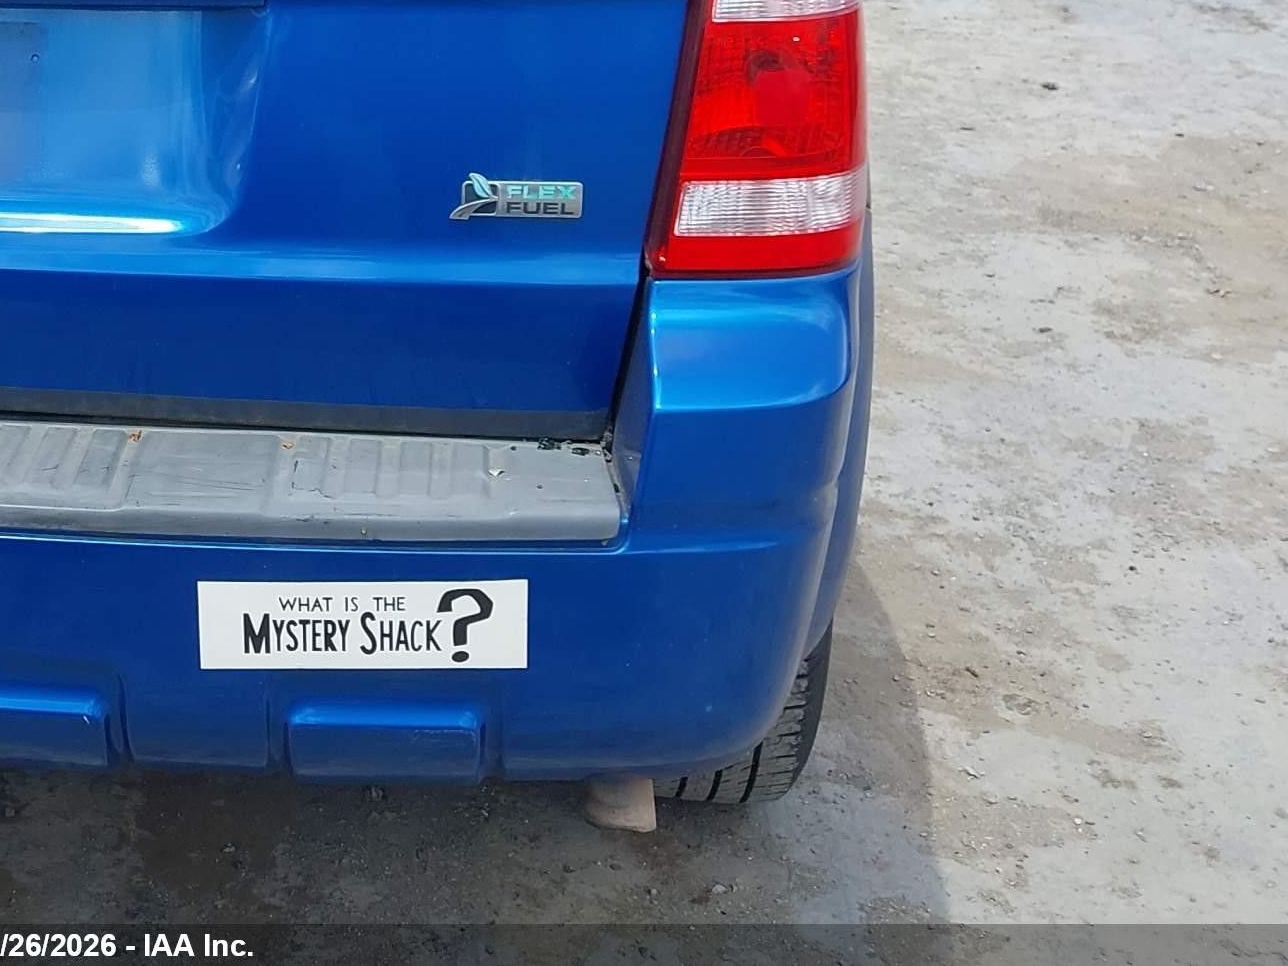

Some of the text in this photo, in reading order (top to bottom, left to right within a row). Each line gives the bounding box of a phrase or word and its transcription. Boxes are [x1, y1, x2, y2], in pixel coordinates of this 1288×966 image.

[506, 185, 577, 199] FLEX
[506, 202, 575, 215] FUEL
[278, 596, 406, 612] WHAT IS THE
